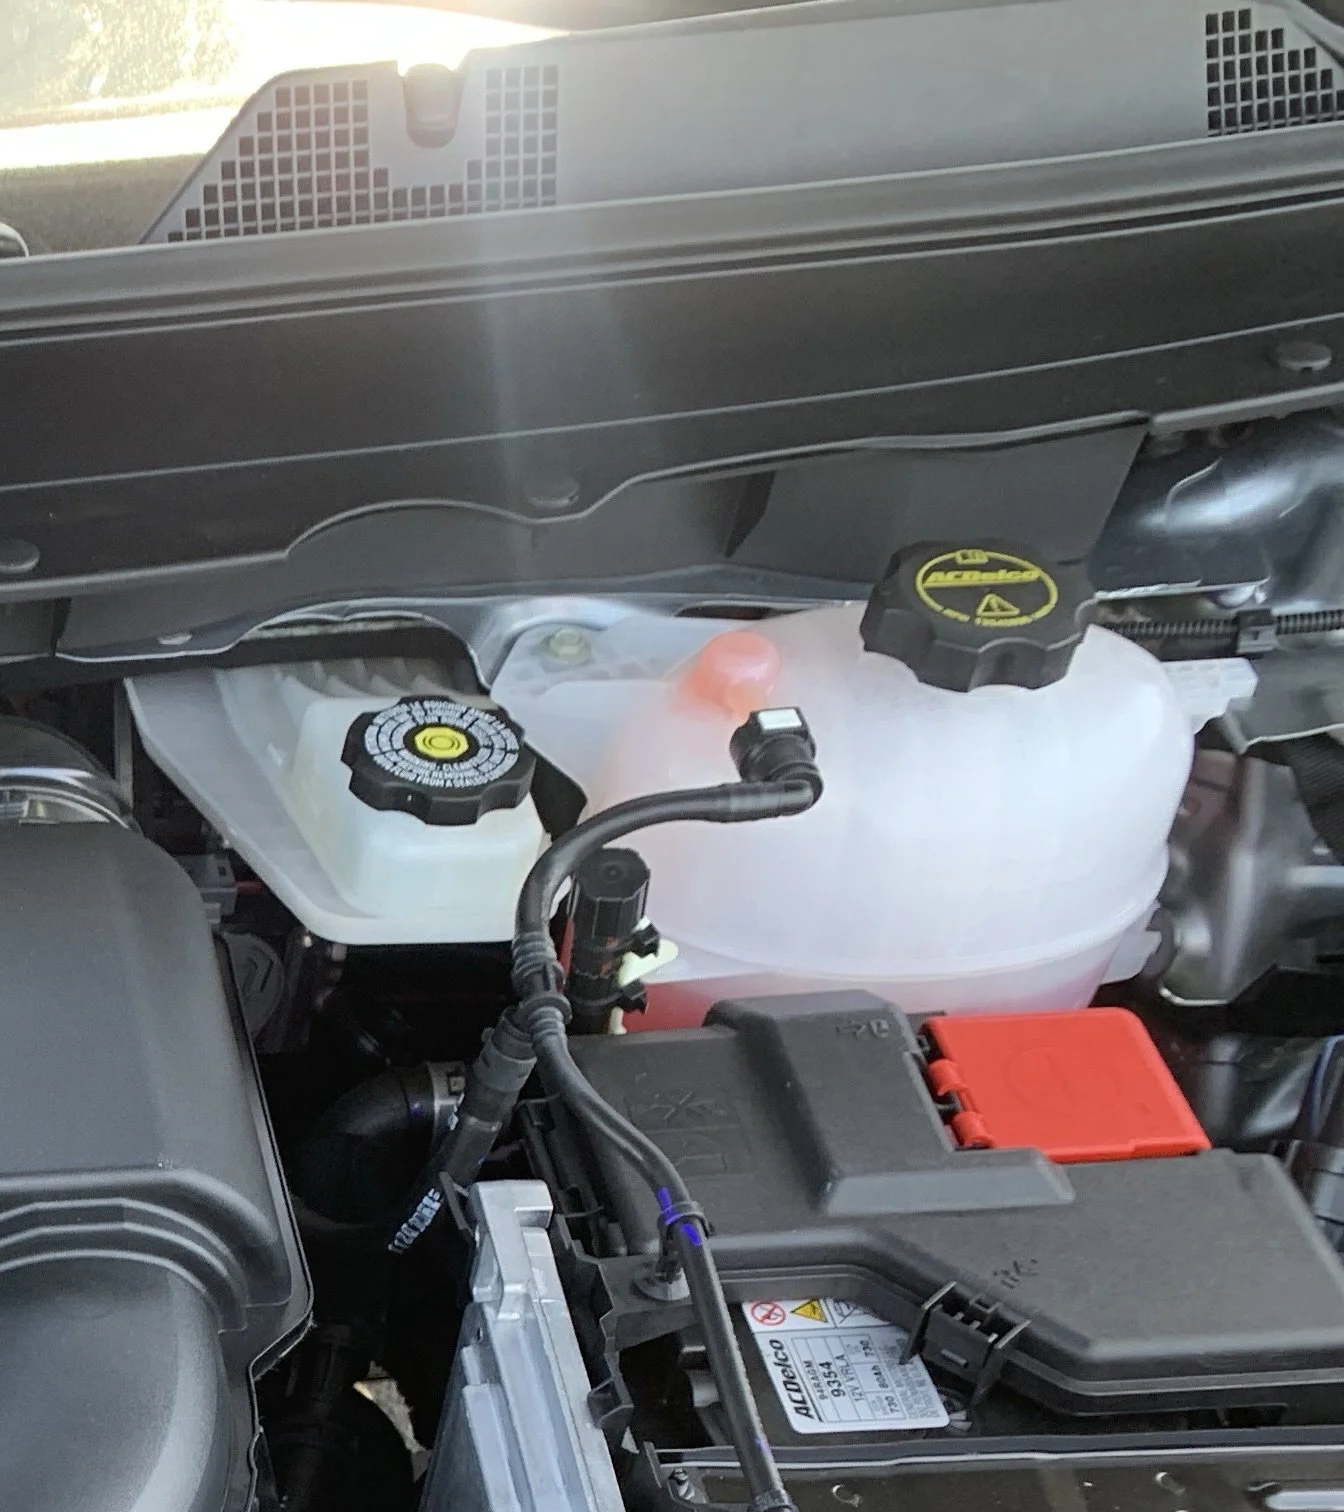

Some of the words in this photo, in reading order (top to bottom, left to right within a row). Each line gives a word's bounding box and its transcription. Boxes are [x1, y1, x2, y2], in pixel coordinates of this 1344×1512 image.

[764, 1339, 814, 1420] ACDelco
[817, 1361, 846, 1396] 9354
[847, 1384, 865, 1400] 12V
